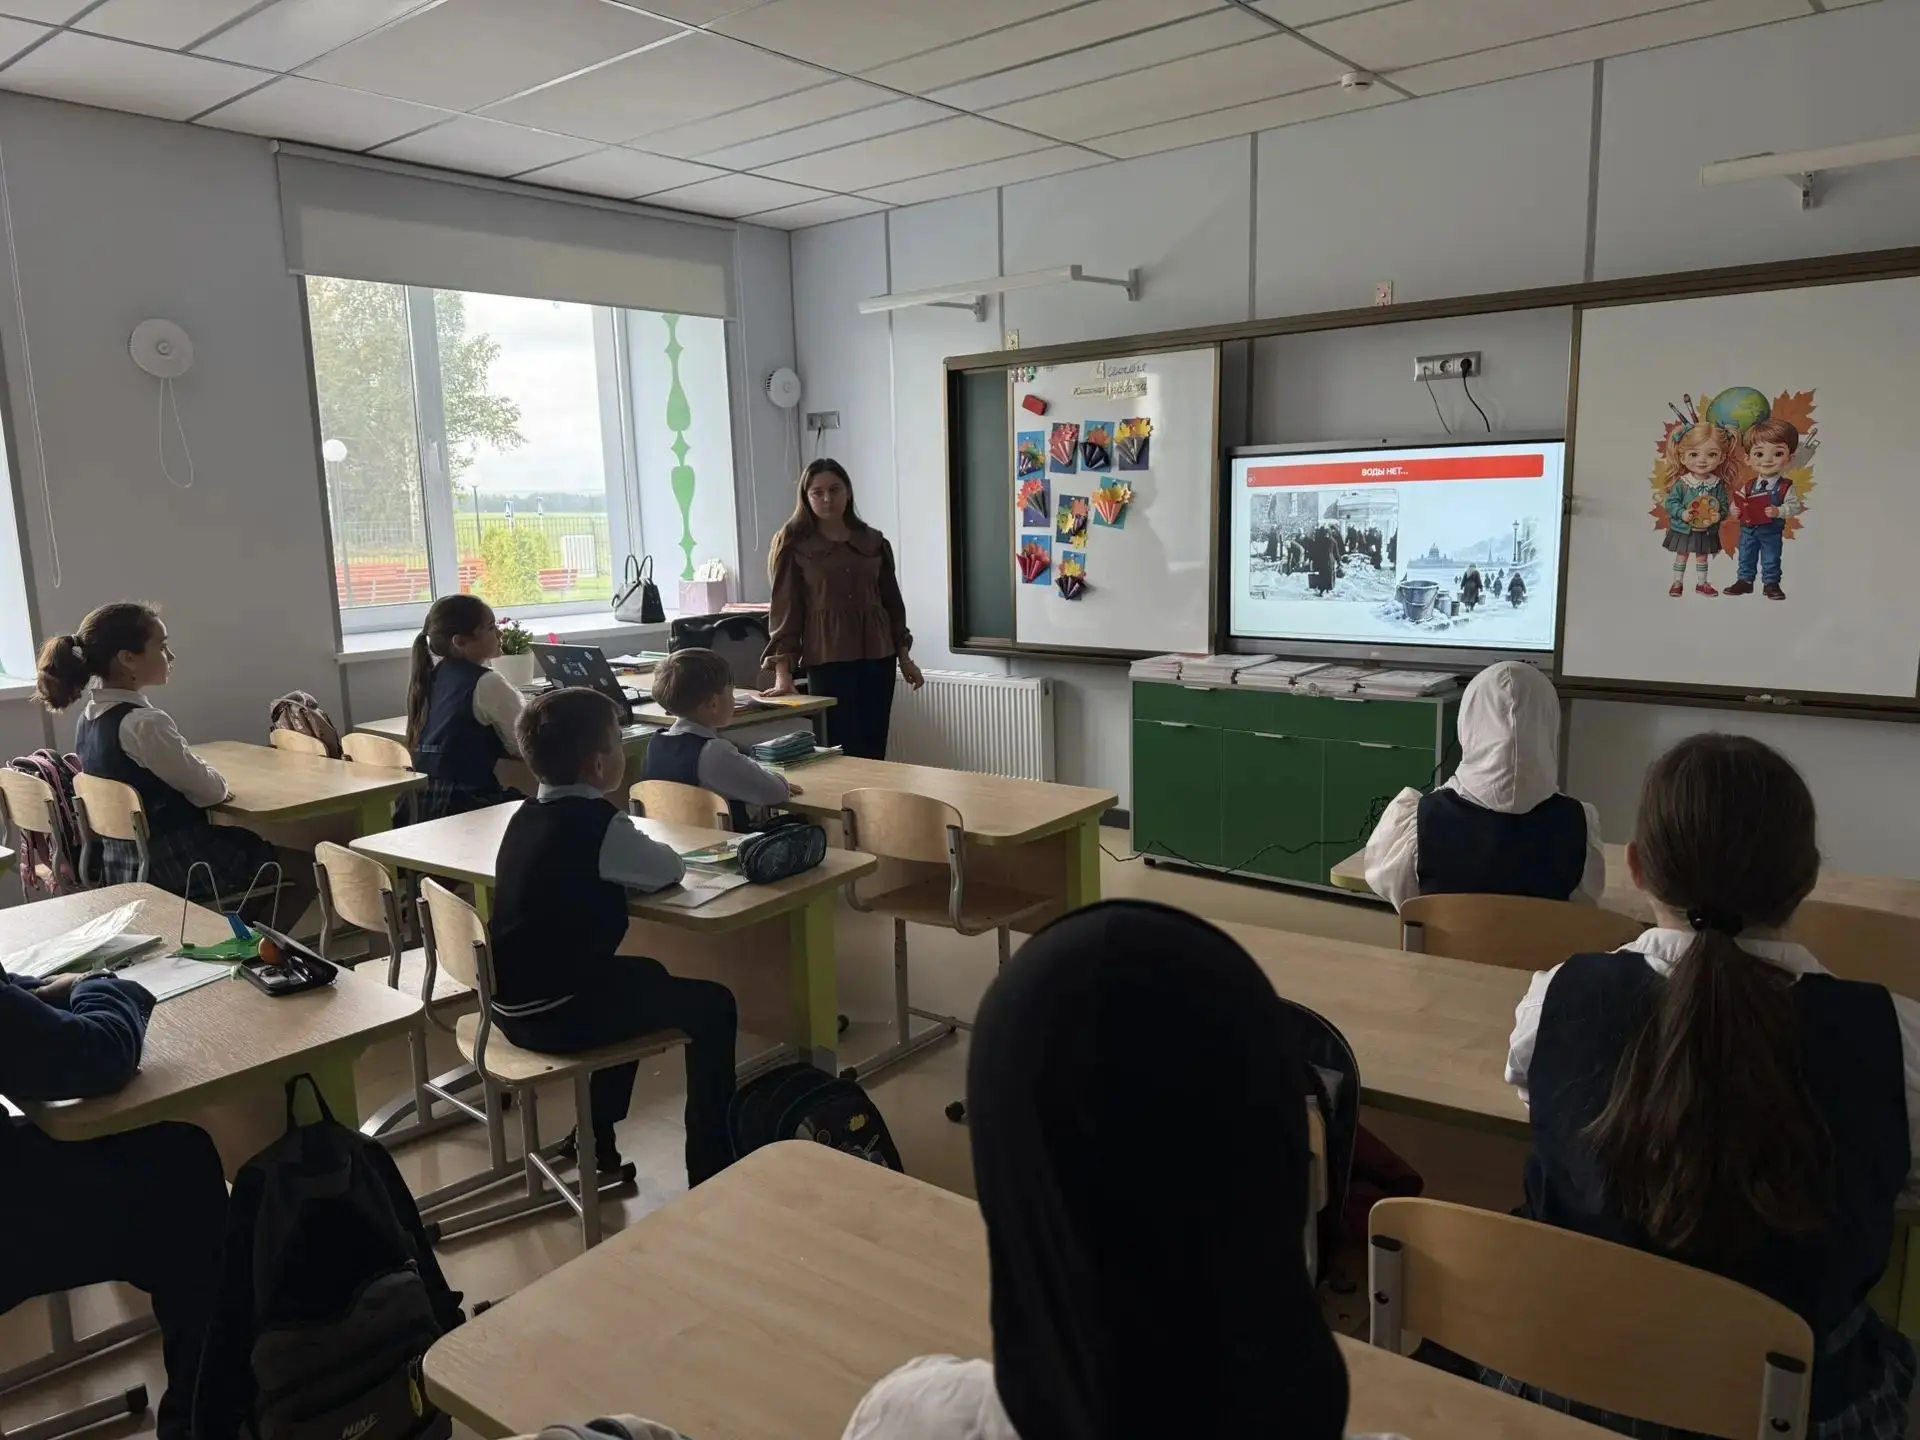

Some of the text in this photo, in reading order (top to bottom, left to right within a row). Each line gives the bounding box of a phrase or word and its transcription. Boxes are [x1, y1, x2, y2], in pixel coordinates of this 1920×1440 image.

[1361, 466, 1409, 477] ВОДЫ НЕТ...
[342, 1412, 378, 1439] NIKE
